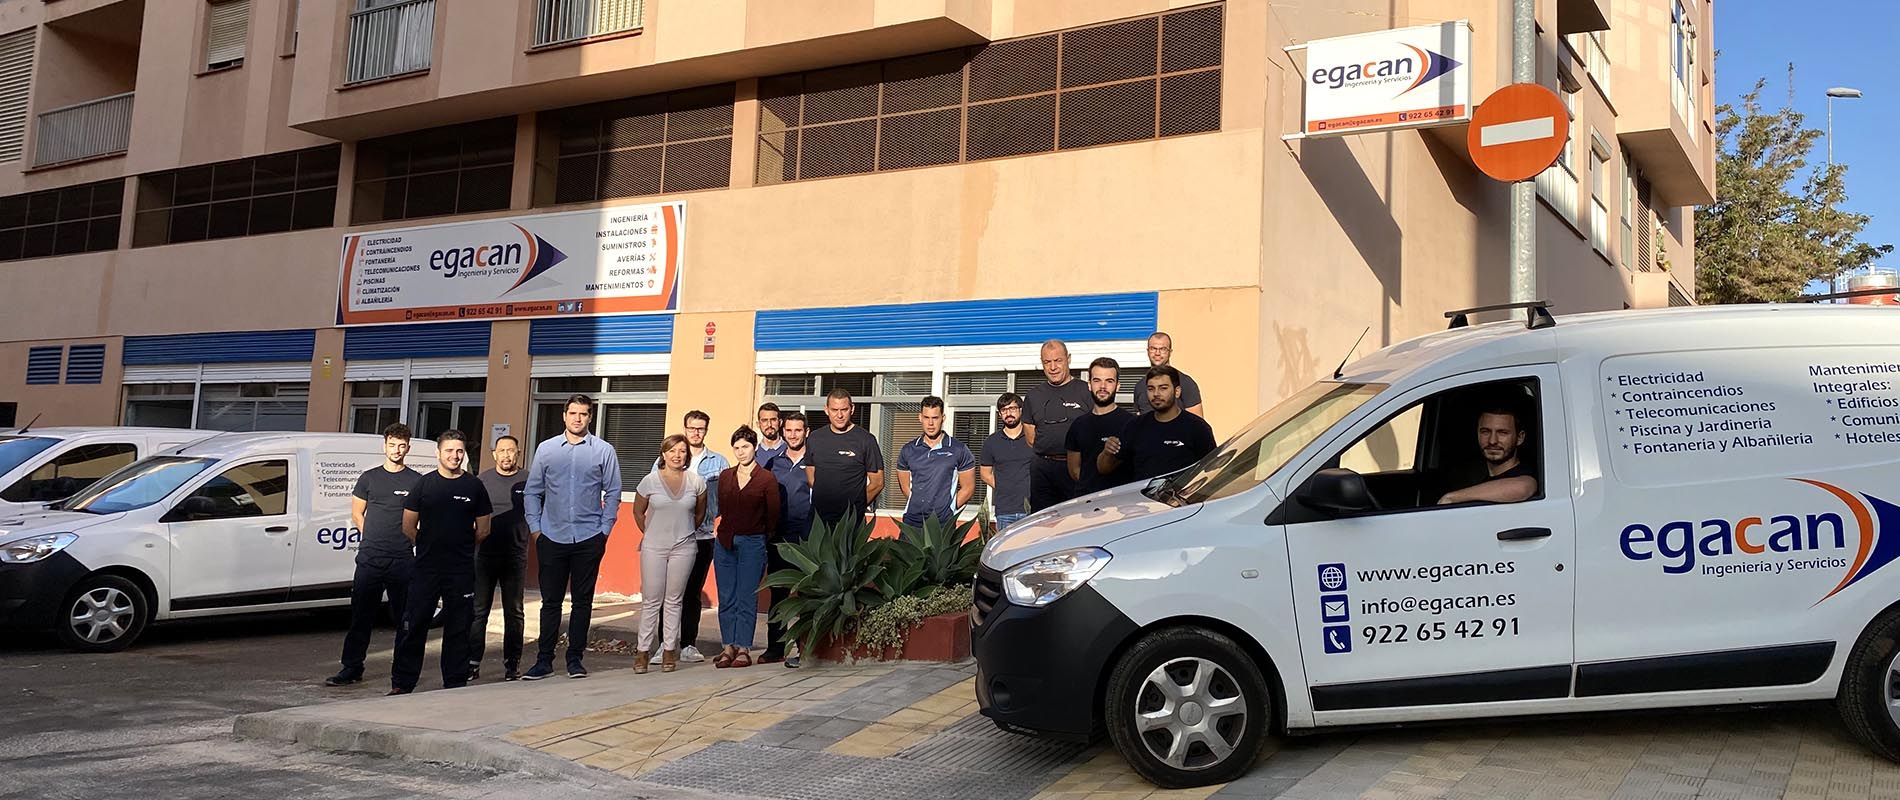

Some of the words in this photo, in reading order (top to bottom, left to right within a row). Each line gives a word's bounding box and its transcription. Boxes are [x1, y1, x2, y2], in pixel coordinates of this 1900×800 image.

[1312, 57, 1412, 89] egacan
[1408, 112, 1422, 120] 922
[1424, 110, 1433, 118] 65
[1435, 108, 1445, 117] 42
[1446, 107, 1455, 116] 91
[595, 227, 648, 239] INSTALACIONES
[367, 236, 402, 246] ELECTRICIDAD
[601, 240, 647, 251] SUMINISTROS
[366, 245, 413, 256] CONTRAINCENDIOS
[429, 243, 522, 279] egacan
[364, 264, 421, 276] TELECOMUNICACIONES
[487, 269, 492, 277] y
[492, 266, 520, 276] Servicios
[608, 267, 645, 277] REFORMAS
[362, 277, 386, 286] PISCINAS
[585, 281, 645, 292] MANTENIMIENTOS
[466, 308, 478, 316] 922
[478, 307, 486, 315] 65
[486, 306, 494, 315] 42
[494, 306, 503, 314] 91
[1617, 371, 1704, 386] Electricidad
[1622, 385, 1744, 403] Contraincendios
[1812, 379, 1892, 396] Integrales:
[1837, 396, 1899, 410] Edificios
[1625, 401, 1776, 420] Telecomunicaciones
[1630, 423, 1681, 437] Piscina
[1684, 424, 1693, 437] y
[1718, 440, 1728, 453] y
[1619, 512, 1846, 575] egacan
[1357, 561, 1515, 583] www.egacan.es
[1775, 562, 1784, 575] y
[1787, 556, 1847, 571] Servicios
[1361, 593, 1516, 615] info@egacan.es
[1362, 624, 1408, 645] 922
[1416, 622, 1447, 642] 65
[1454, 619, 1484, 639] 42
[1492, 617, 1519, 637] 91
